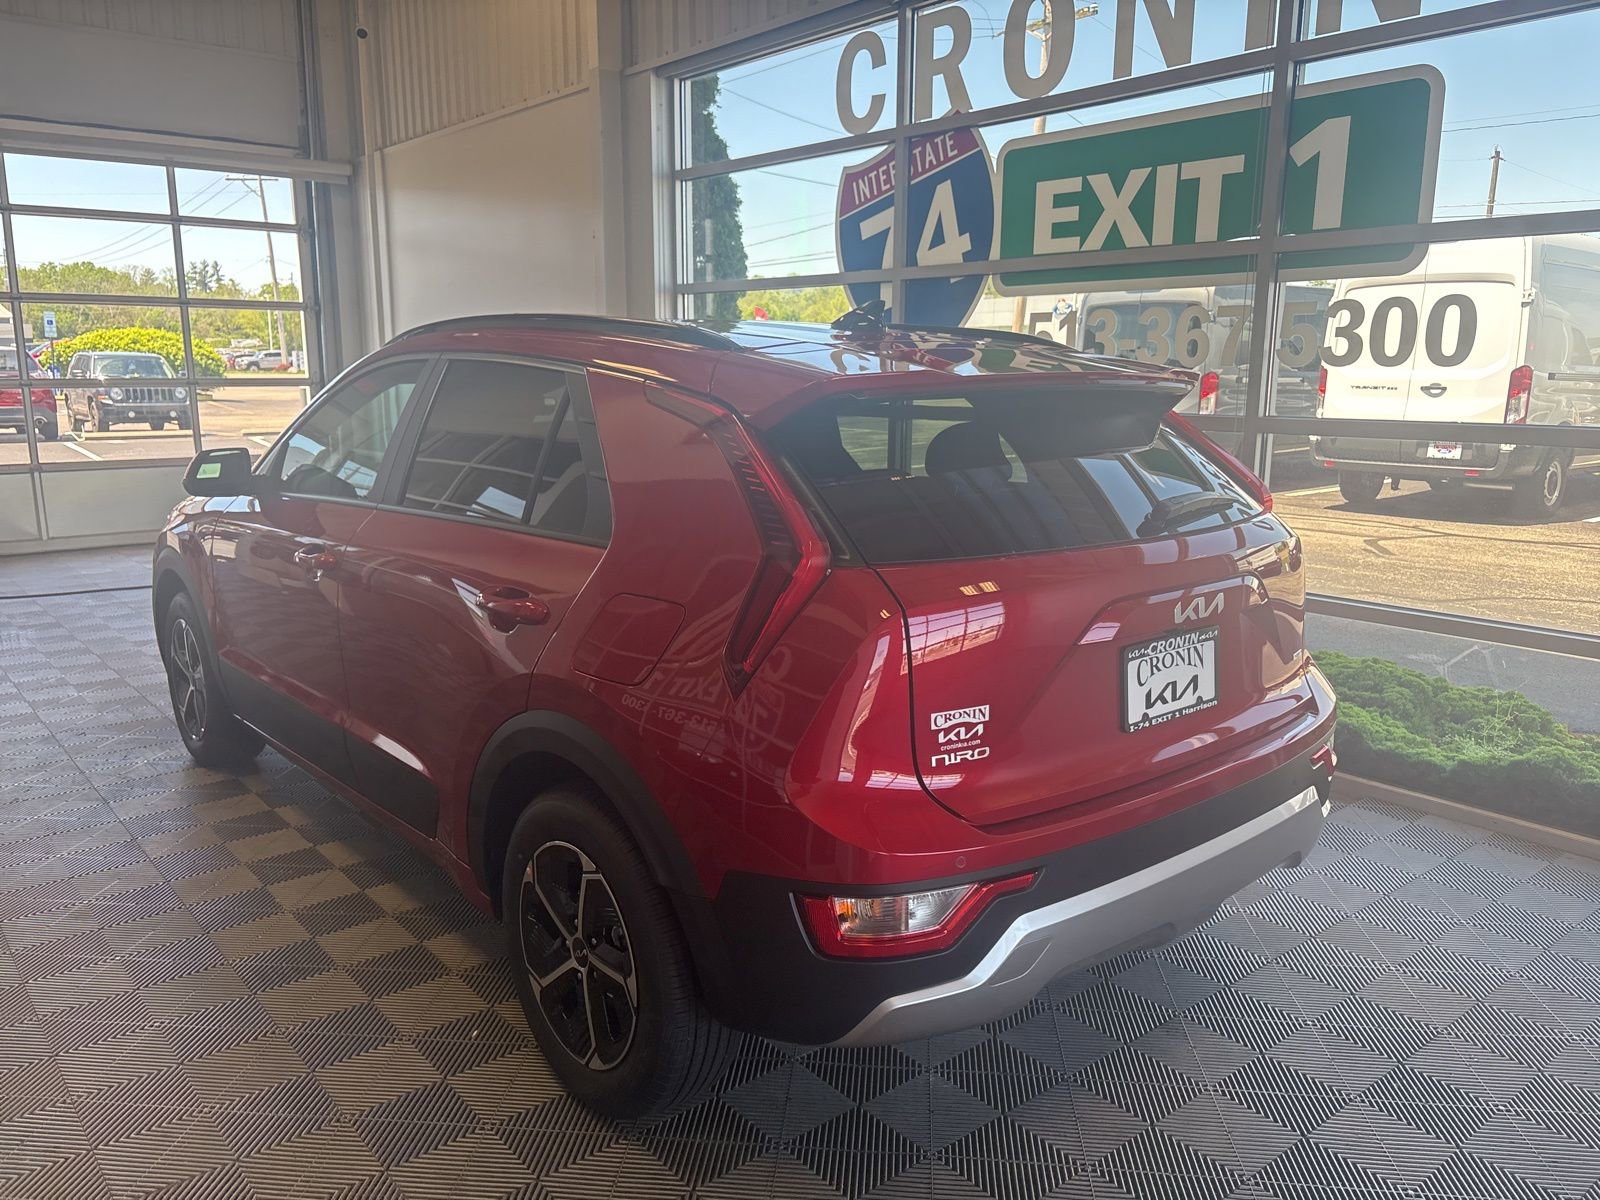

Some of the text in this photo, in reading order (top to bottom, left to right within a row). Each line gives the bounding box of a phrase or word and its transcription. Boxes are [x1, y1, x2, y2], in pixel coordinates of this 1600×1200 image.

[836, 0, 1421, 136] CRON
[853, 131, 959, 205] INTERTATE
[1033, 115, 1352, 255] EXIT 1
[859, 179, 972, 310] 74
[1028, 294, 1478, 368] 513-3675300
[1174, 592, 1225, 624] KIA
[1148, 631, 1199, 656] CRONIN
[1136, 643, 1204, 687] CRONIN
[1145, 673, 1199, 710] KIA
[933, 706, 987, 728] CRONIN
[1129, 719, 1150, 732] I-74
[1151, 713, 1173, 726] EXIT
[1182, 700, 1218, 716] Harrison
[938, 723, 984, 744] KIA
[940, 739, 981, 751] croninkia.com
[931, 746, 990, 767] NIRO
